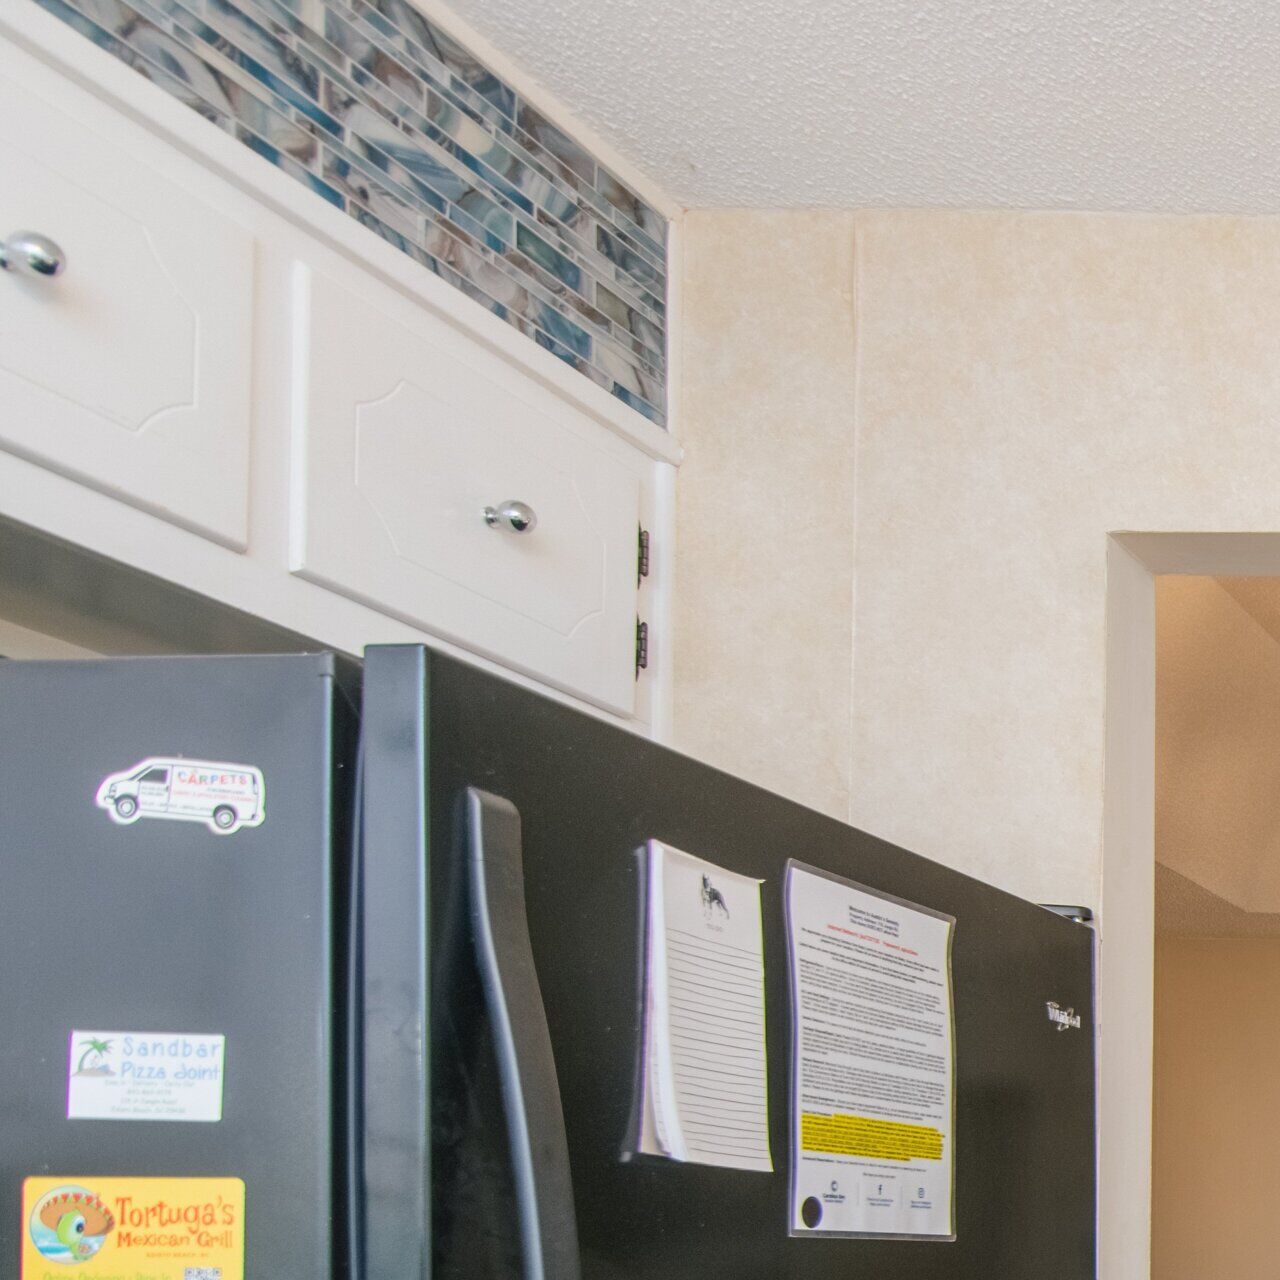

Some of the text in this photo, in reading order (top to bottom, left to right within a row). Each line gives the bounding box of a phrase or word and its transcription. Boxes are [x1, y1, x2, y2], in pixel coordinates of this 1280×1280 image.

[177, 772, 248, 786] CARPETS
[122, 1034, 221, 1059] Sandbar
[120, 1060, 221, 1081] Pizza Joint
[115, 1195, 235, 1235] Tortuga's
[116, 1230, 234, 1249] Mexican Grill
